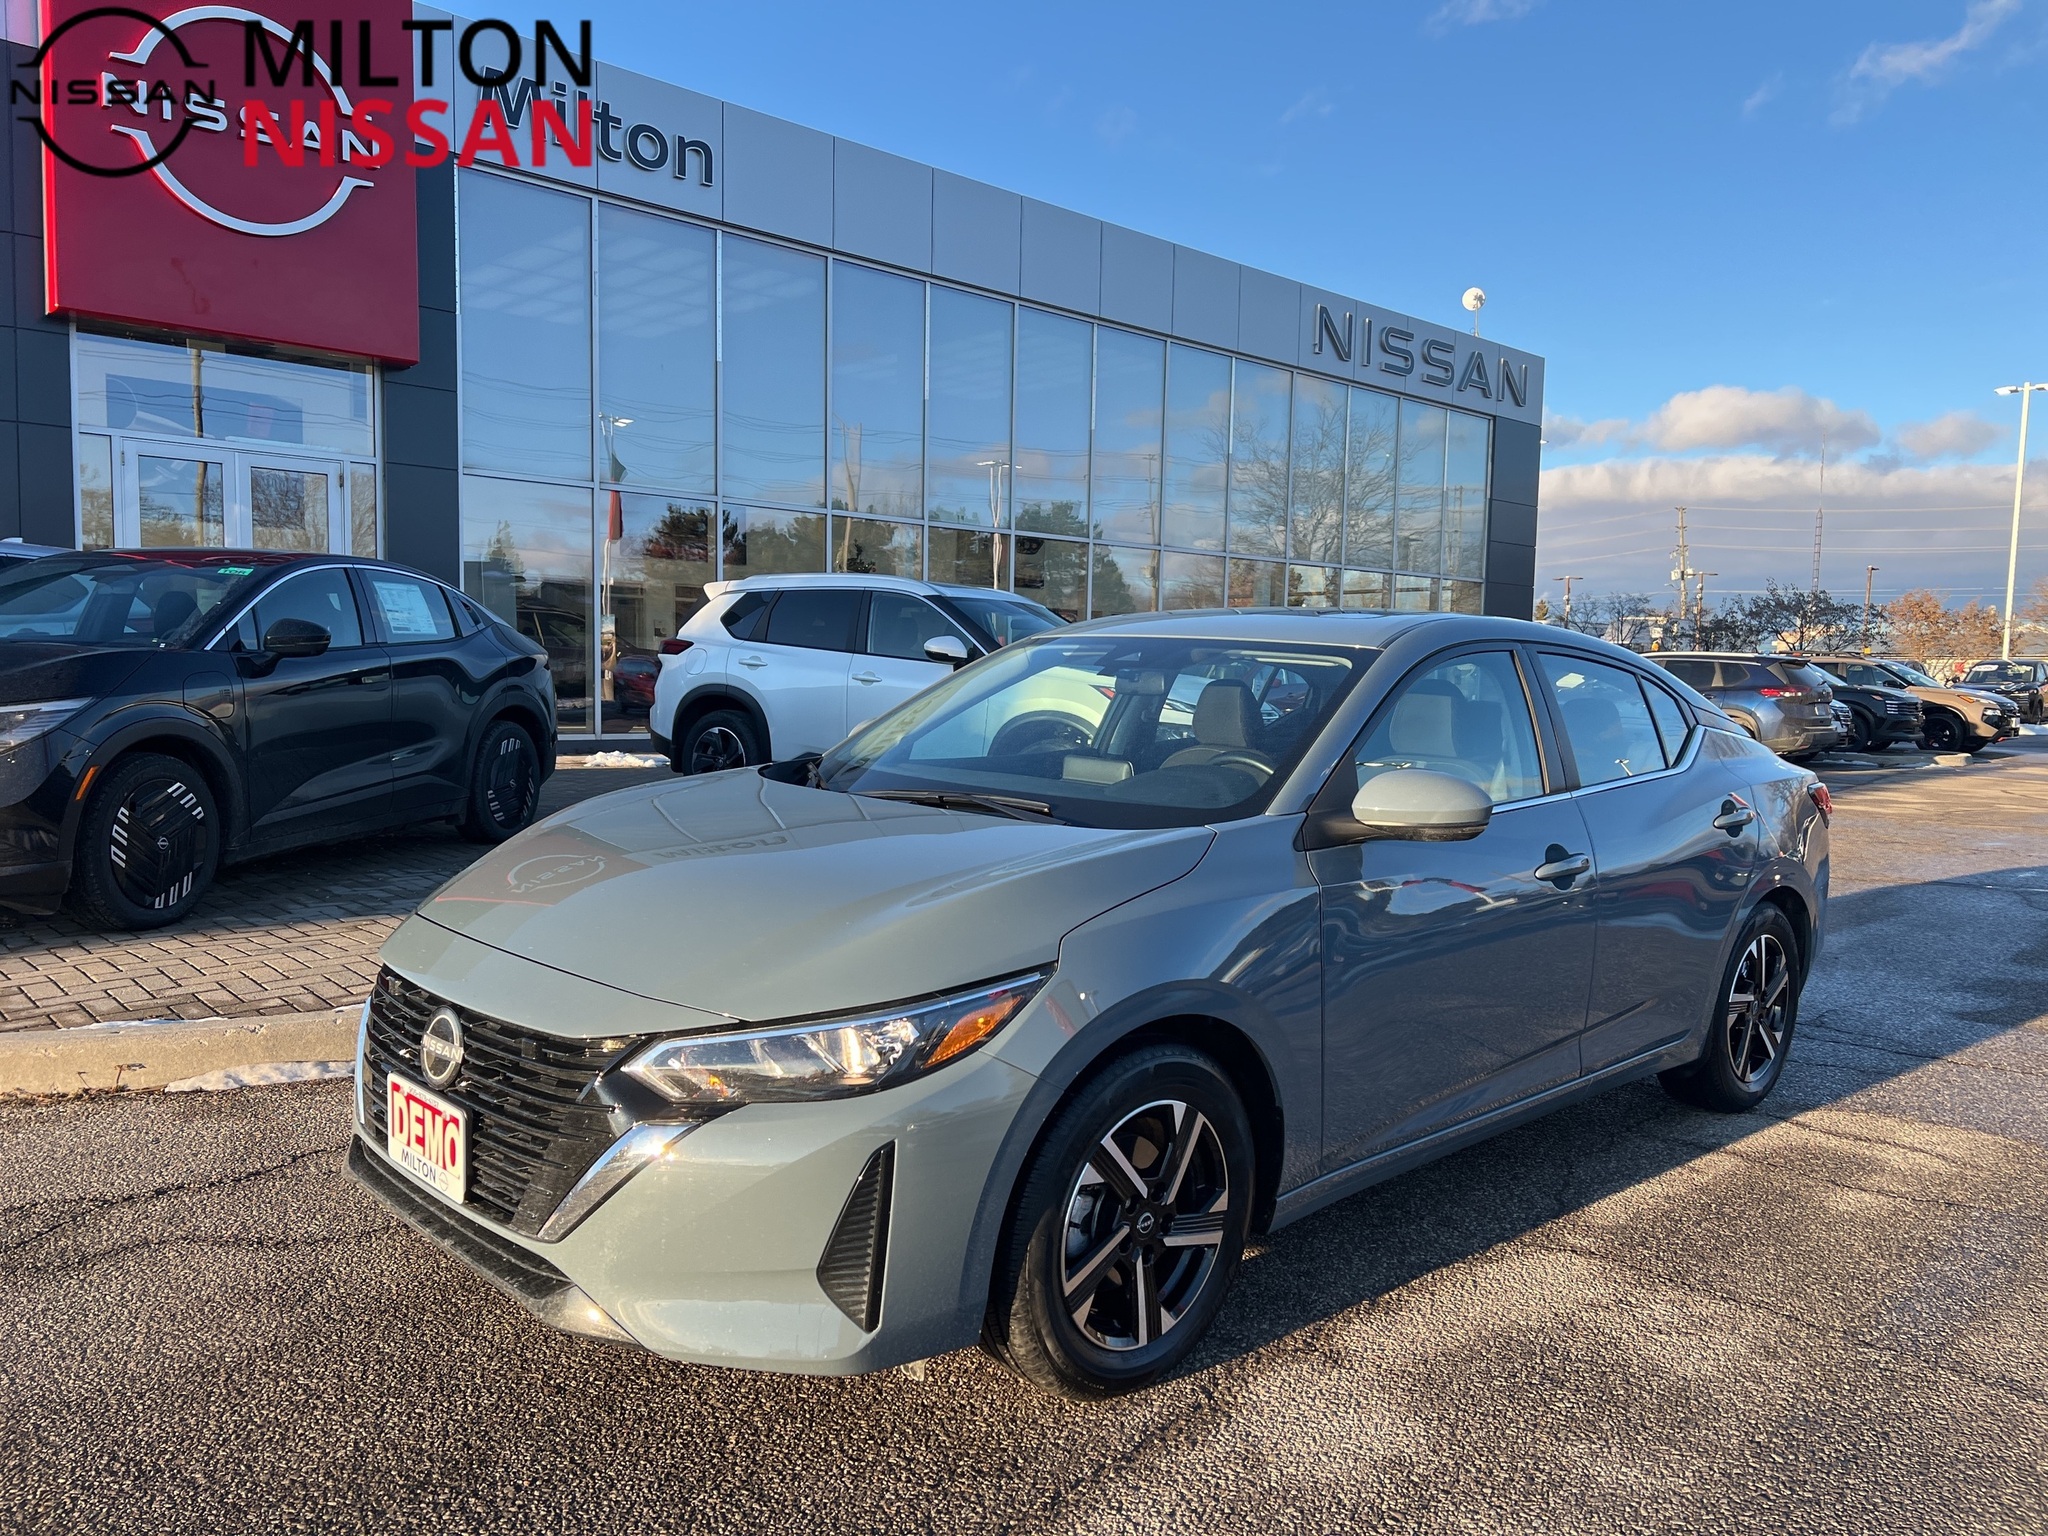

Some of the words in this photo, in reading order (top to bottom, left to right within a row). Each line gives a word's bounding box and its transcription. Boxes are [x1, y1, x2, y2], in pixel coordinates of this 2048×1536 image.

[1313, 303, 1528, 407] NISSAN
[423, 1034, 461, 1061] NISSAN
[393, 1089, 460, 1177] DEMO
[401, 1148, 436, 1184] MILTON
